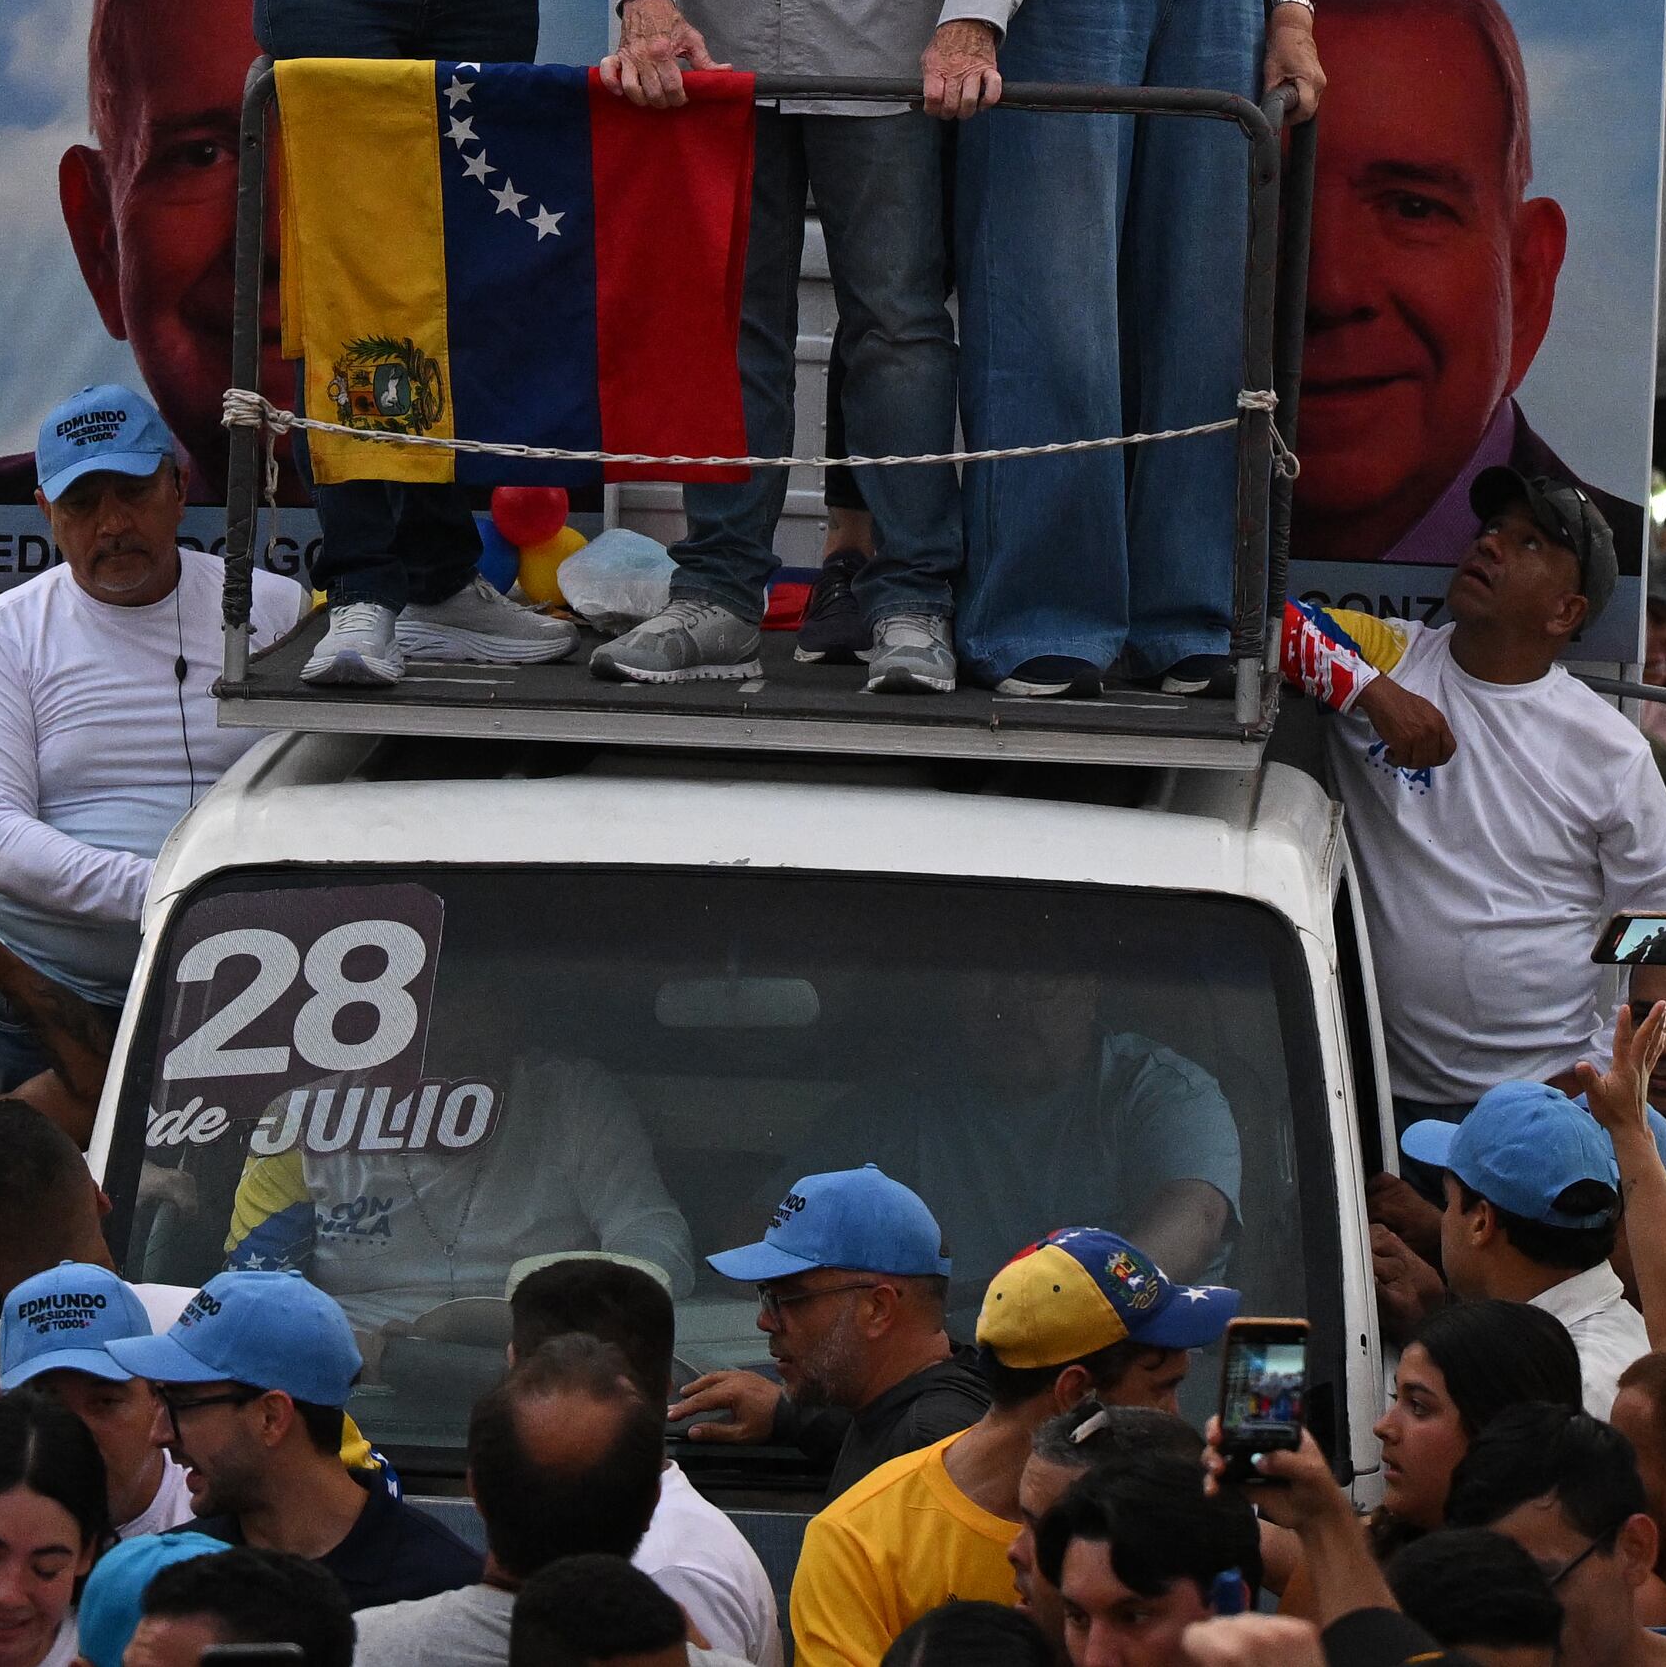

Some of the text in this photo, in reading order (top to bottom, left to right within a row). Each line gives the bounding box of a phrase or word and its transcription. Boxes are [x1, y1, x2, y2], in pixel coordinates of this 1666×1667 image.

[56, 410, 127, 437] EDMUNDO
[66, 423, 120, 442] PRESIDENTE
[163, 919, 427, 1080] 28
[145, 1083, 495, 1155] de JULIO
[19, 1293, 107, 1320] EDMUNDO
[28, 1309, 97, 1327] PRESIDENTE
